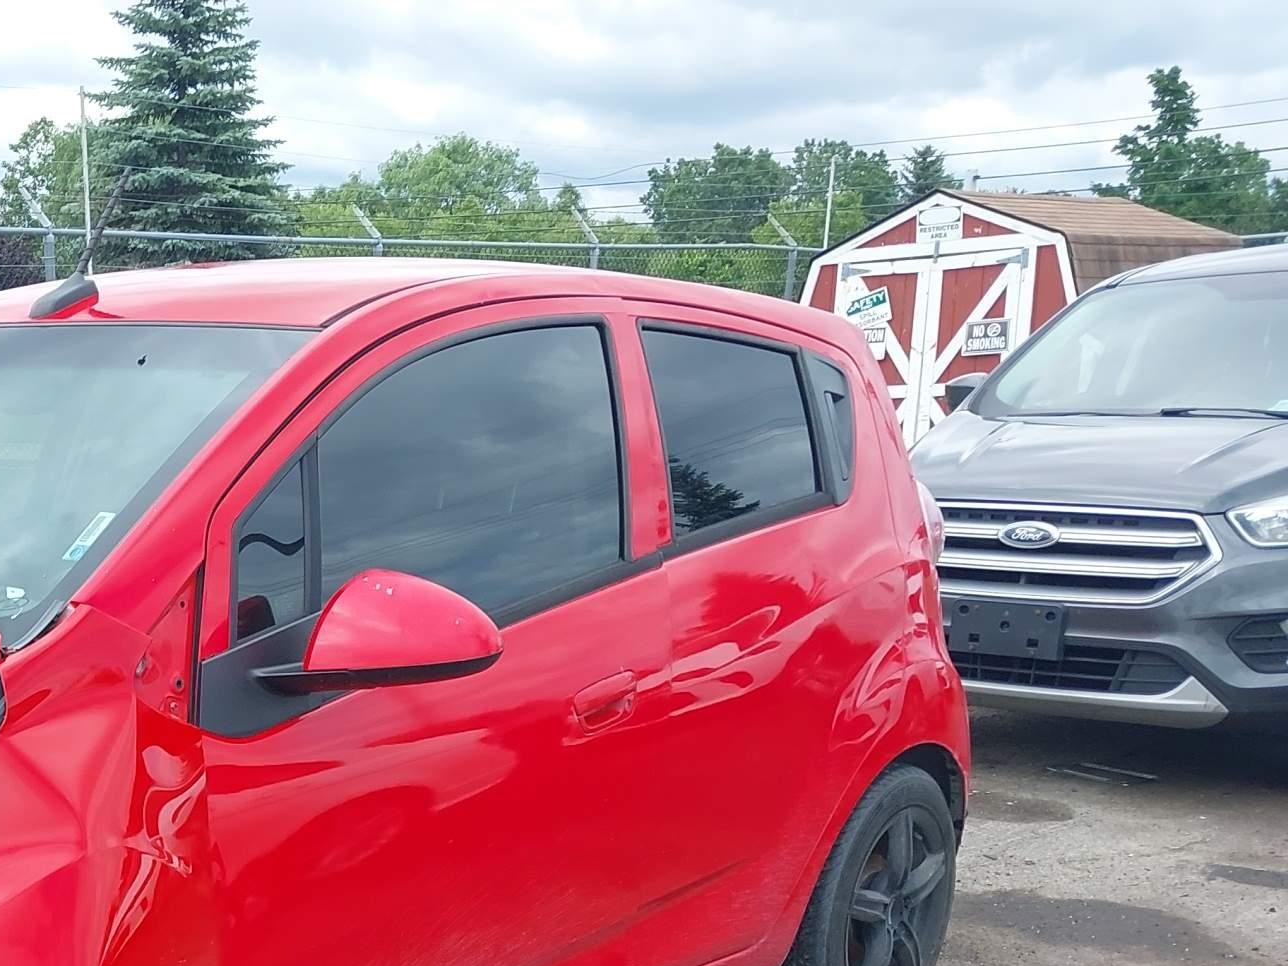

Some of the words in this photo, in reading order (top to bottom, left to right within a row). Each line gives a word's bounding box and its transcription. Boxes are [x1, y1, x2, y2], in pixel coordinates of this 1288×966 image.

[919, 223, 960, 233] RESTRICTED
[973, 324, 985, 338] NO
[967, 335, 1006, 351] SMOKING
[1011, 527, 1044, 541] Ford
